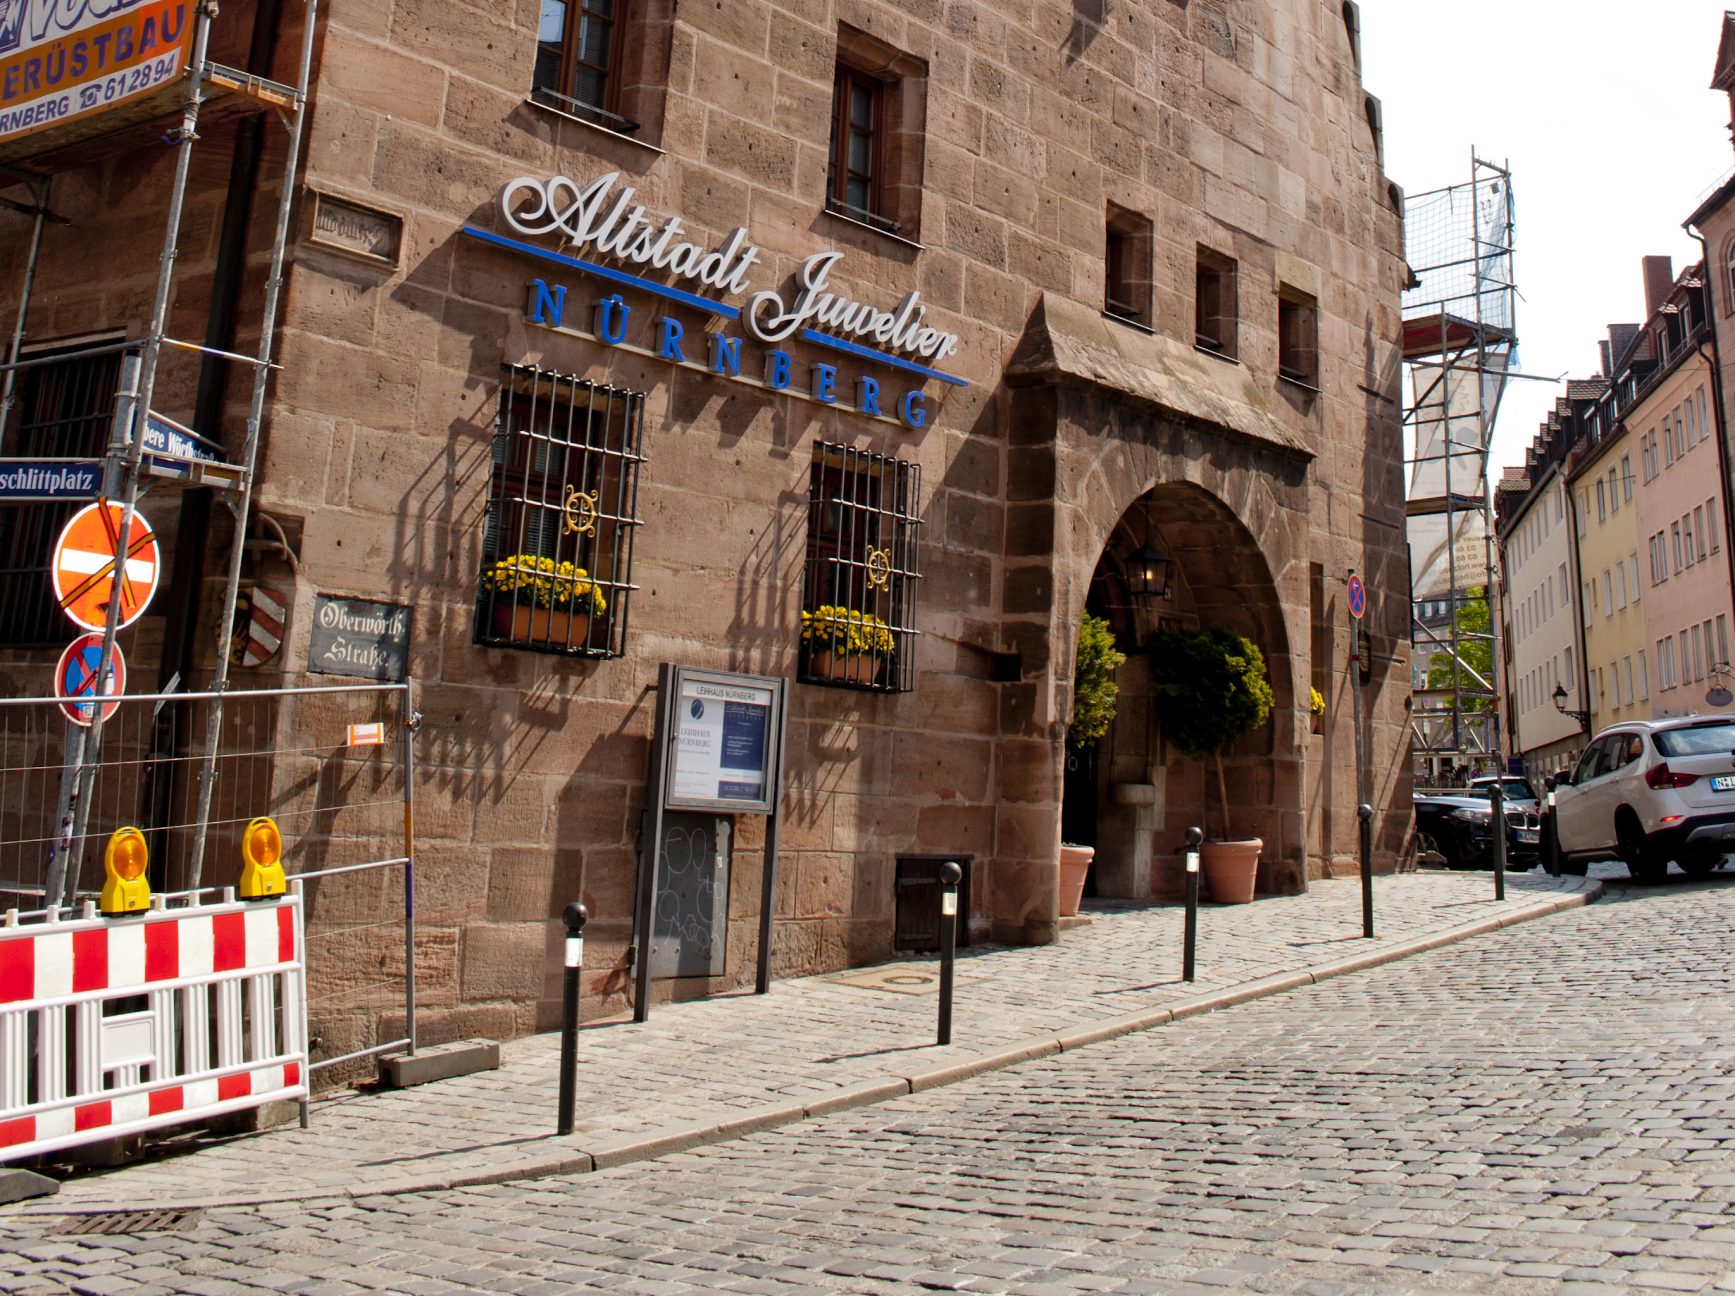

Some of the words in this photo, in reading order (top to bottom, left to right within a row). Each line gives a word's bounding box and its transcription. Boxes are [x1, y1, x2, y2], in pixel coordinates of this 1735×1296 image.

[497, 171, 760, 295] Altstadt
[745, 251, 959, 360] Juwelier
[527, 277, 927, 429] NÜRNBERG
[144, 421, 165, 449] bere
